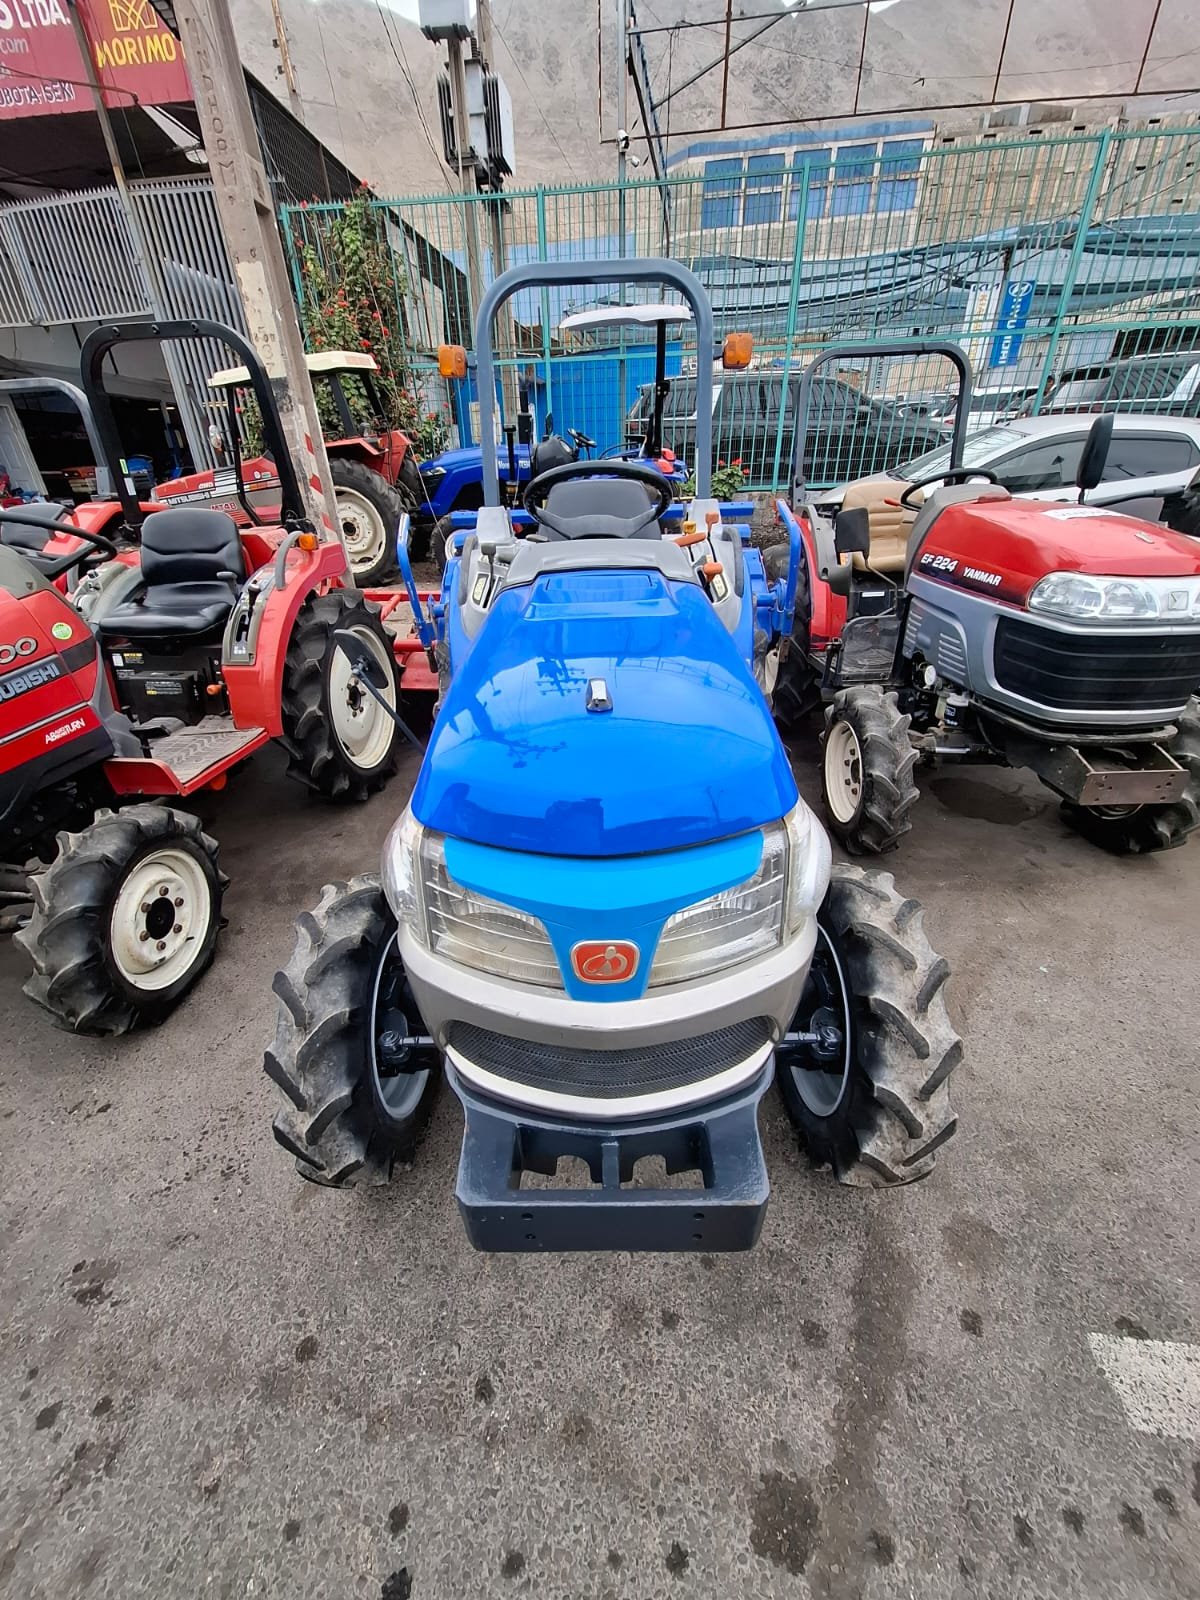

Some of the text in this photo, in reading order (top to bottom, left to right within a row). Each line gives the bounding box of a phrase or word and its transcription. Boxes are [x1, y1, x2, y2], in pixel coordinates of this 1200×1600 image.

[94, 31, 185, 68] MORIMO
[168, 491, 210, 506] MITSUBISHI
[920, 553, 1002, 587] EF 224 YANMAR
[0, 661, 61, 703] UBISHI
